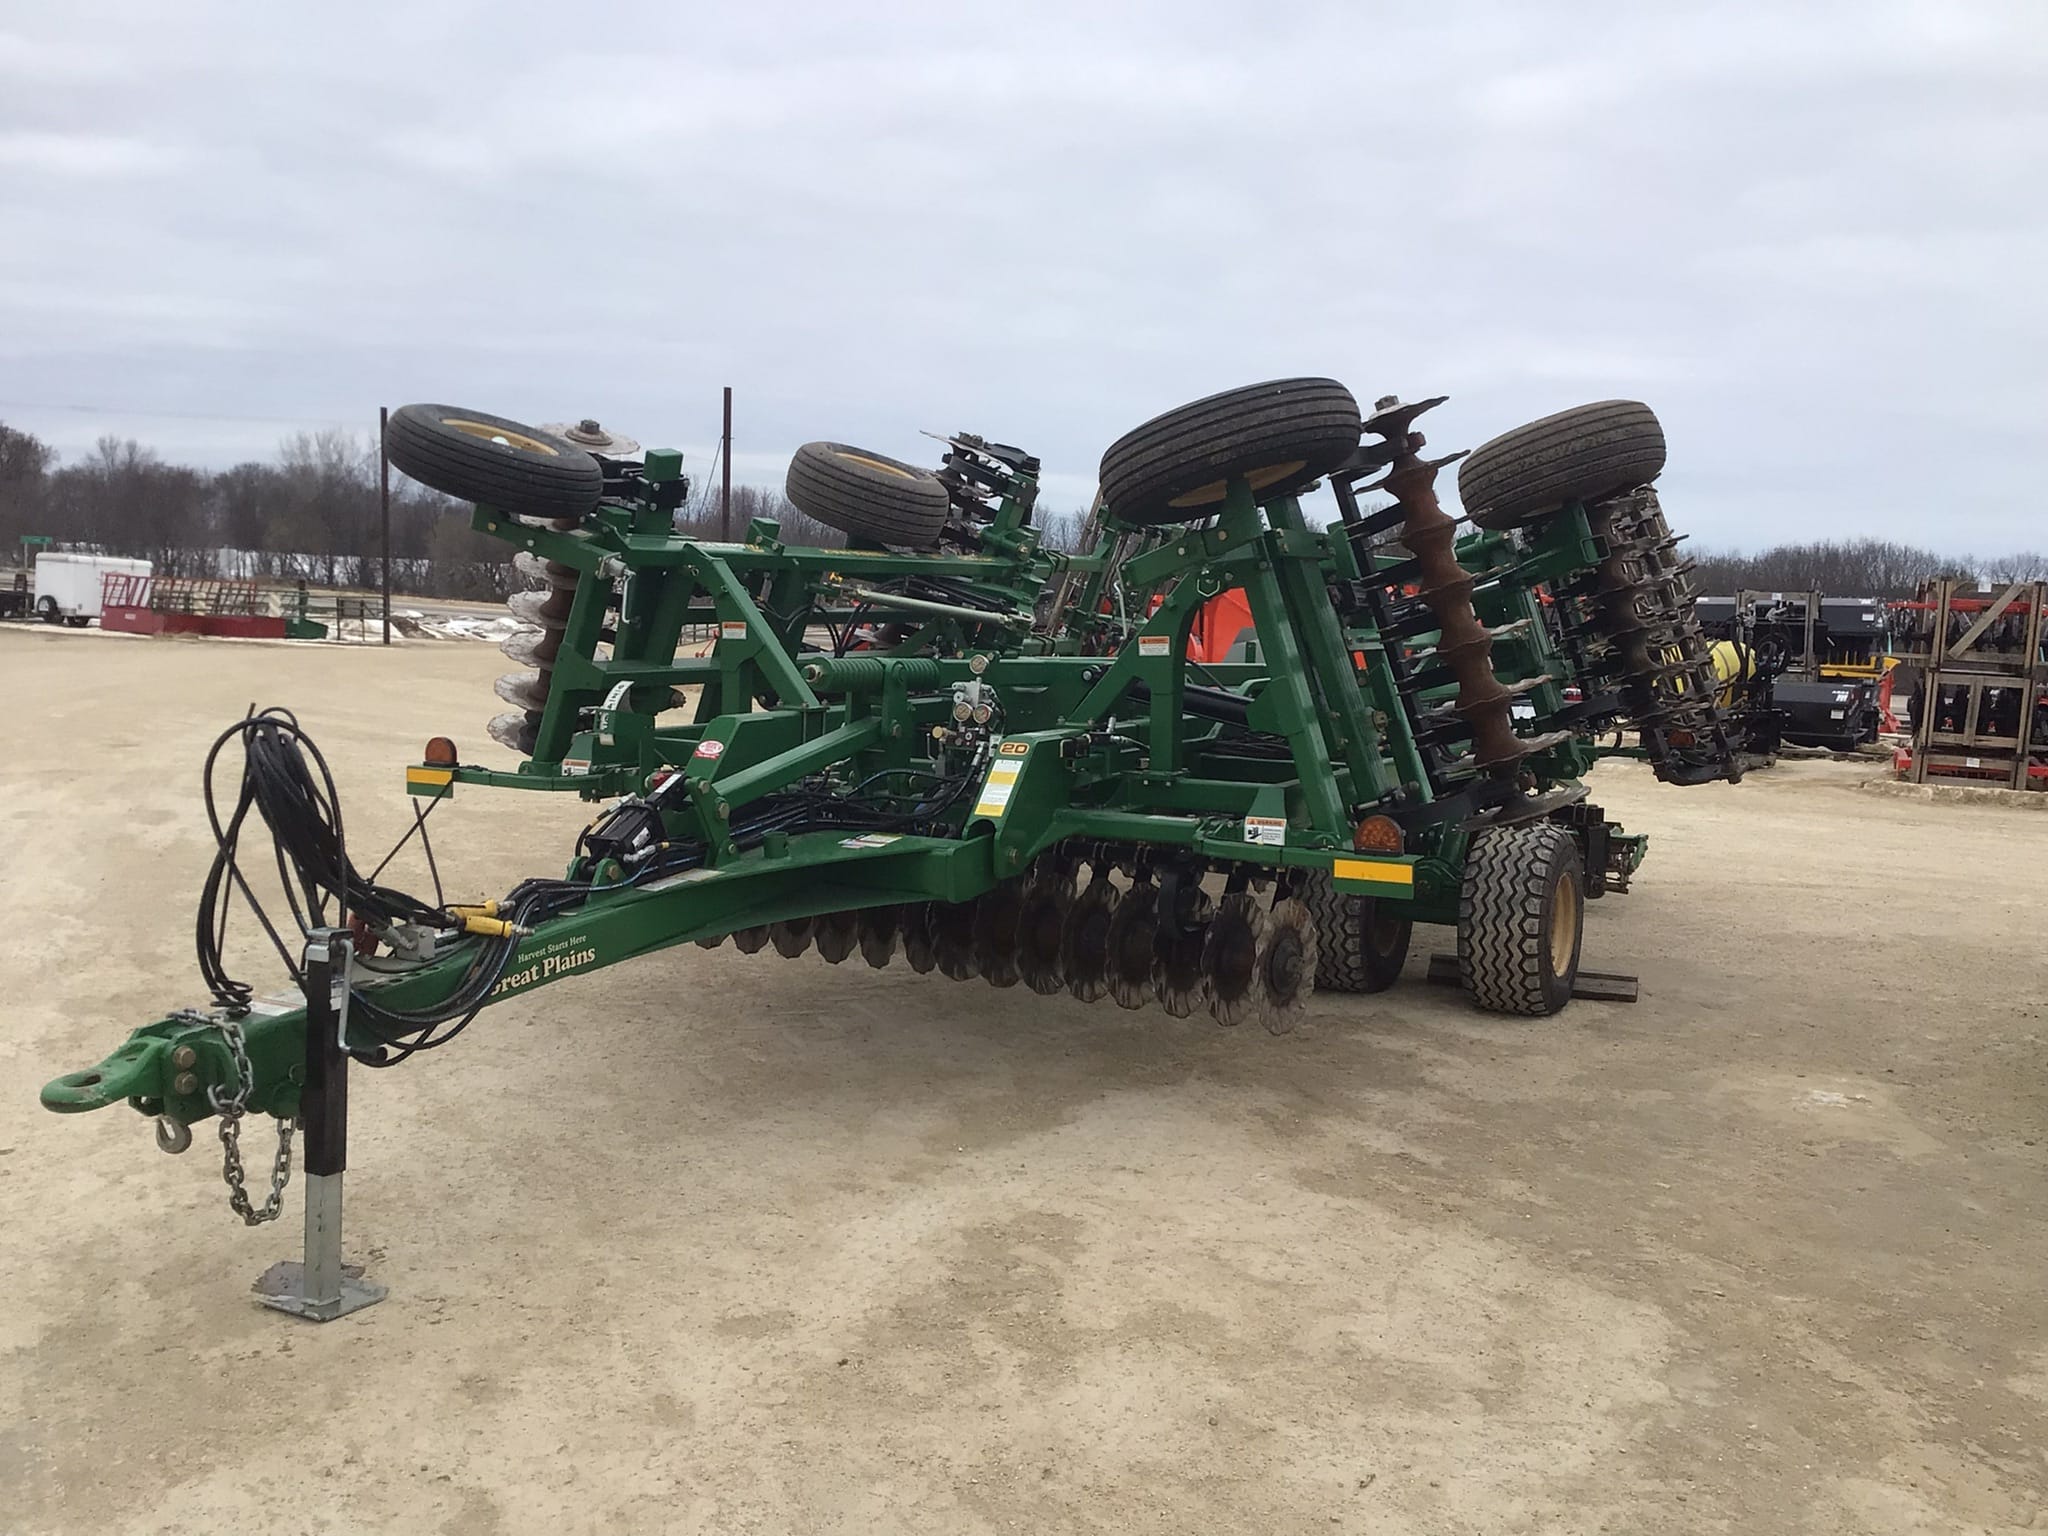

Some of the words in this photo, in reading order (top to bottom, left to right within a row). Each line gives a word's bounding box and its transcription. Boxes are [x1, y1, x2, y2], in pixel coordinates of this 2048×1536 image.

[1001, 743, 1028, 754] 20
[518, 947, 547, 963] Harvest
[547, 940, 569, 954] Starts
[569, 935, 587, 946] Here
[542, 948, 596, 977] Plains
